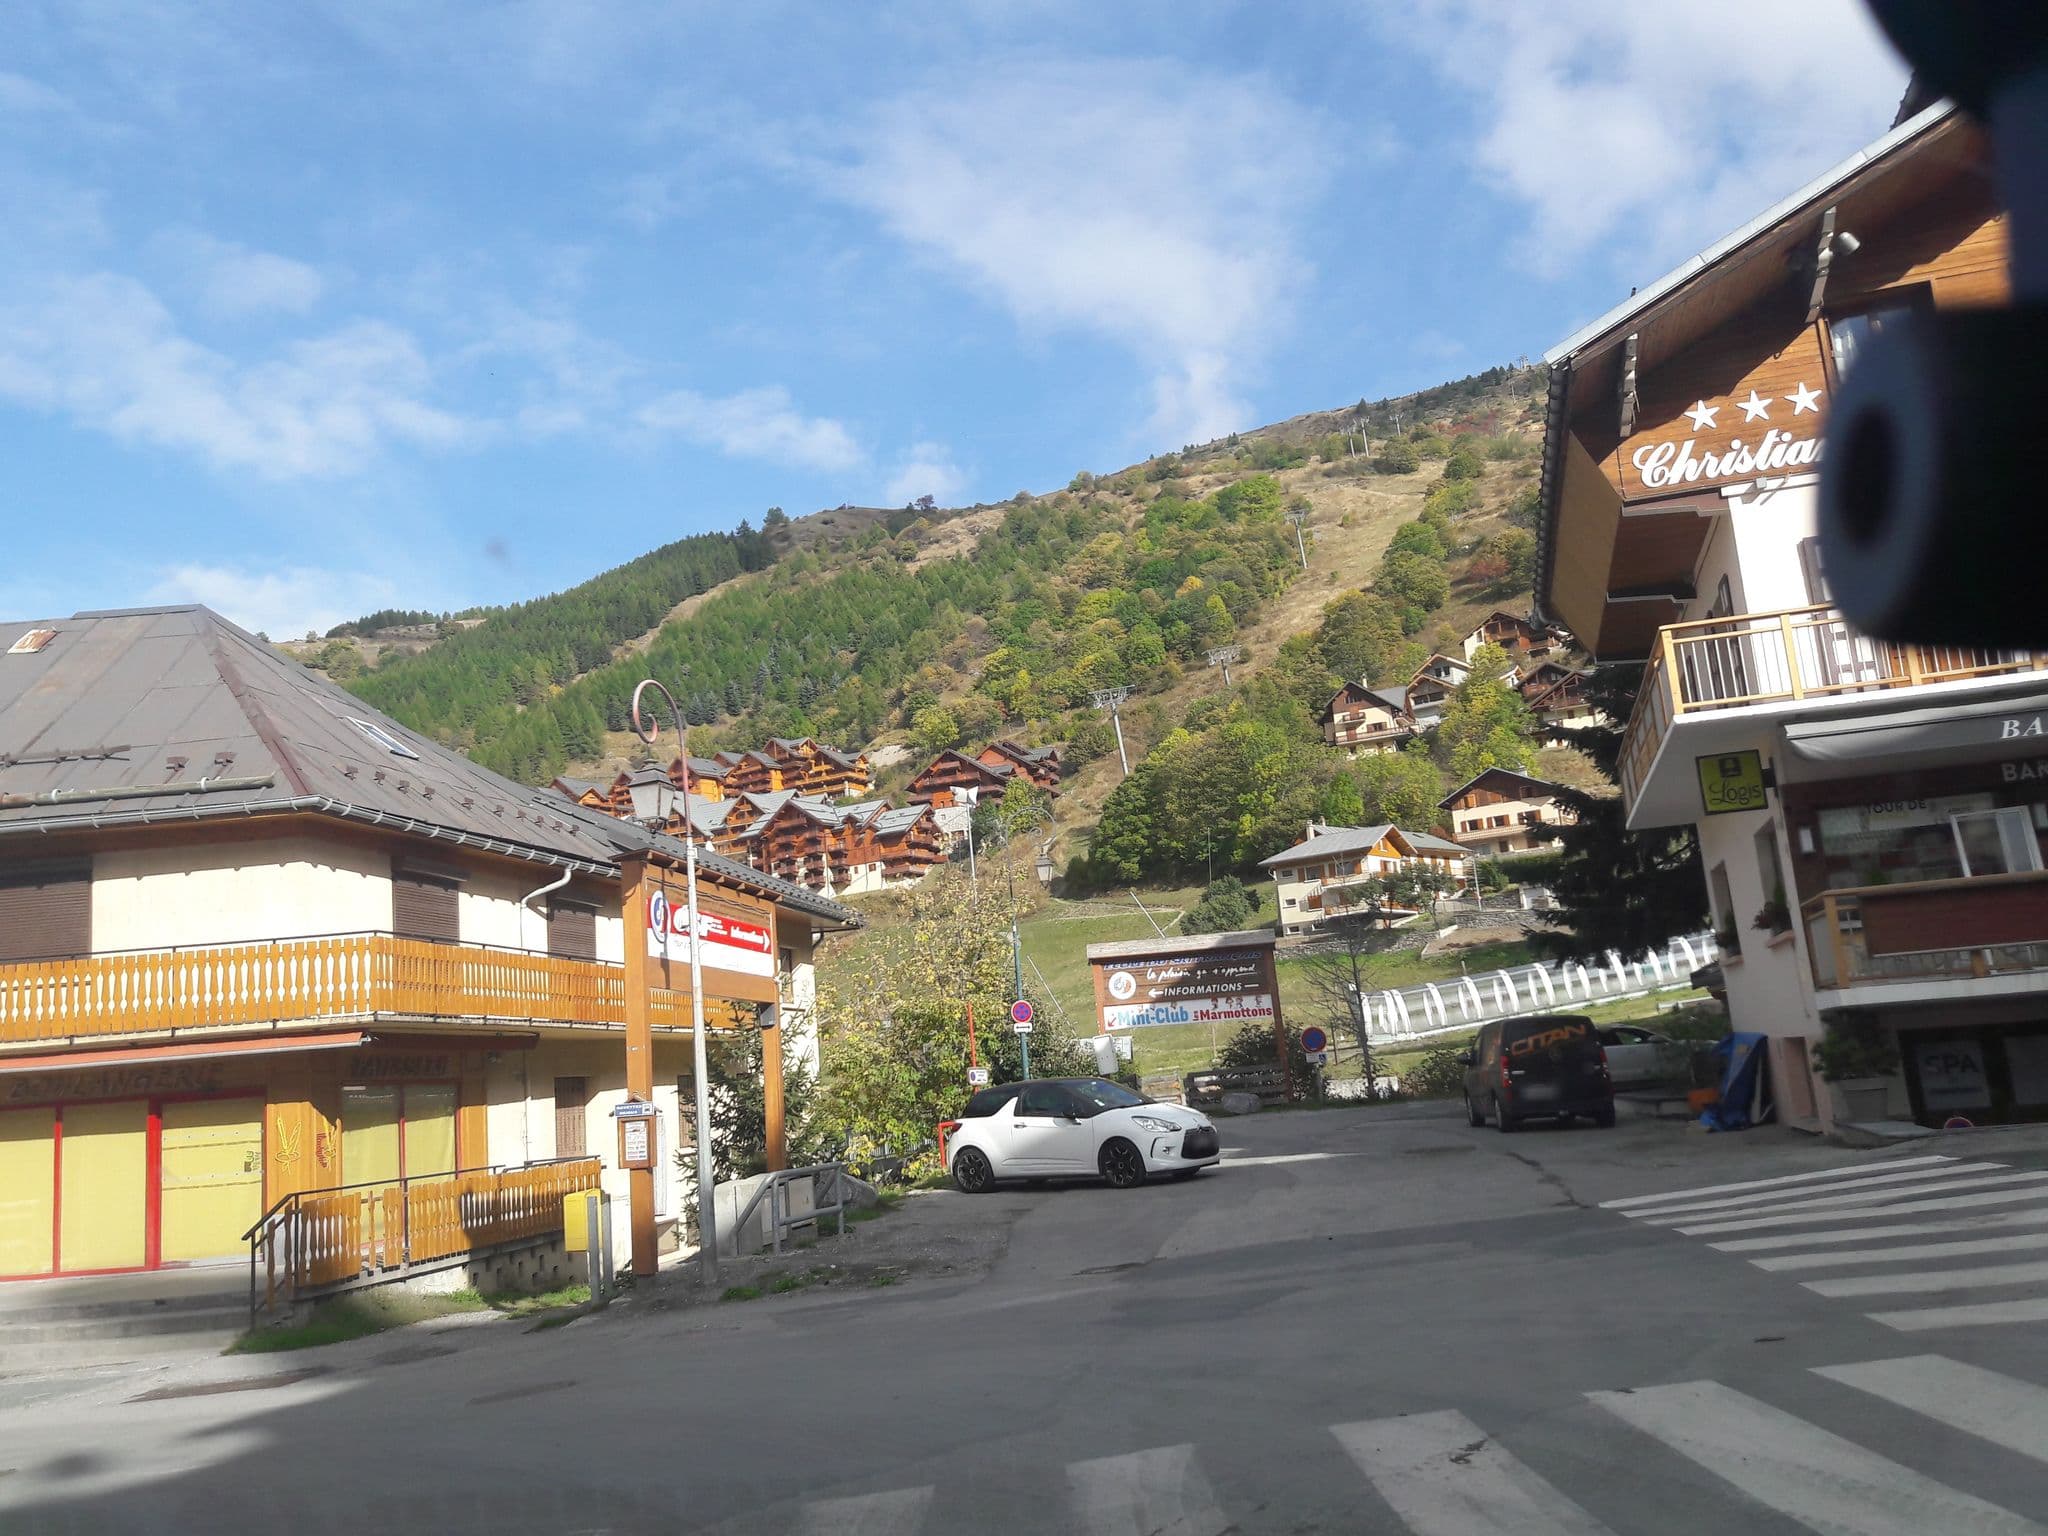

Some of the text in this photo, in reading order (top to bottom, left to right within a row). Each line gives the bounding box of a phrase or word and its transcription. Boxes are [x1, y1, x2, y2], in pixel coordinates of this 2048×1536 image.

[2000, 716, 2048, 739] BA
[1708, 779, 1763, 805] Logis
[1164, 982, 1242, 997] INFORMATIONS
[1117, 1006, 1189, 1026] Mini-Club
[1200, 1006, 1272, 1021] Marmottons
[1924, 1055, 1979, 1074] SPA
